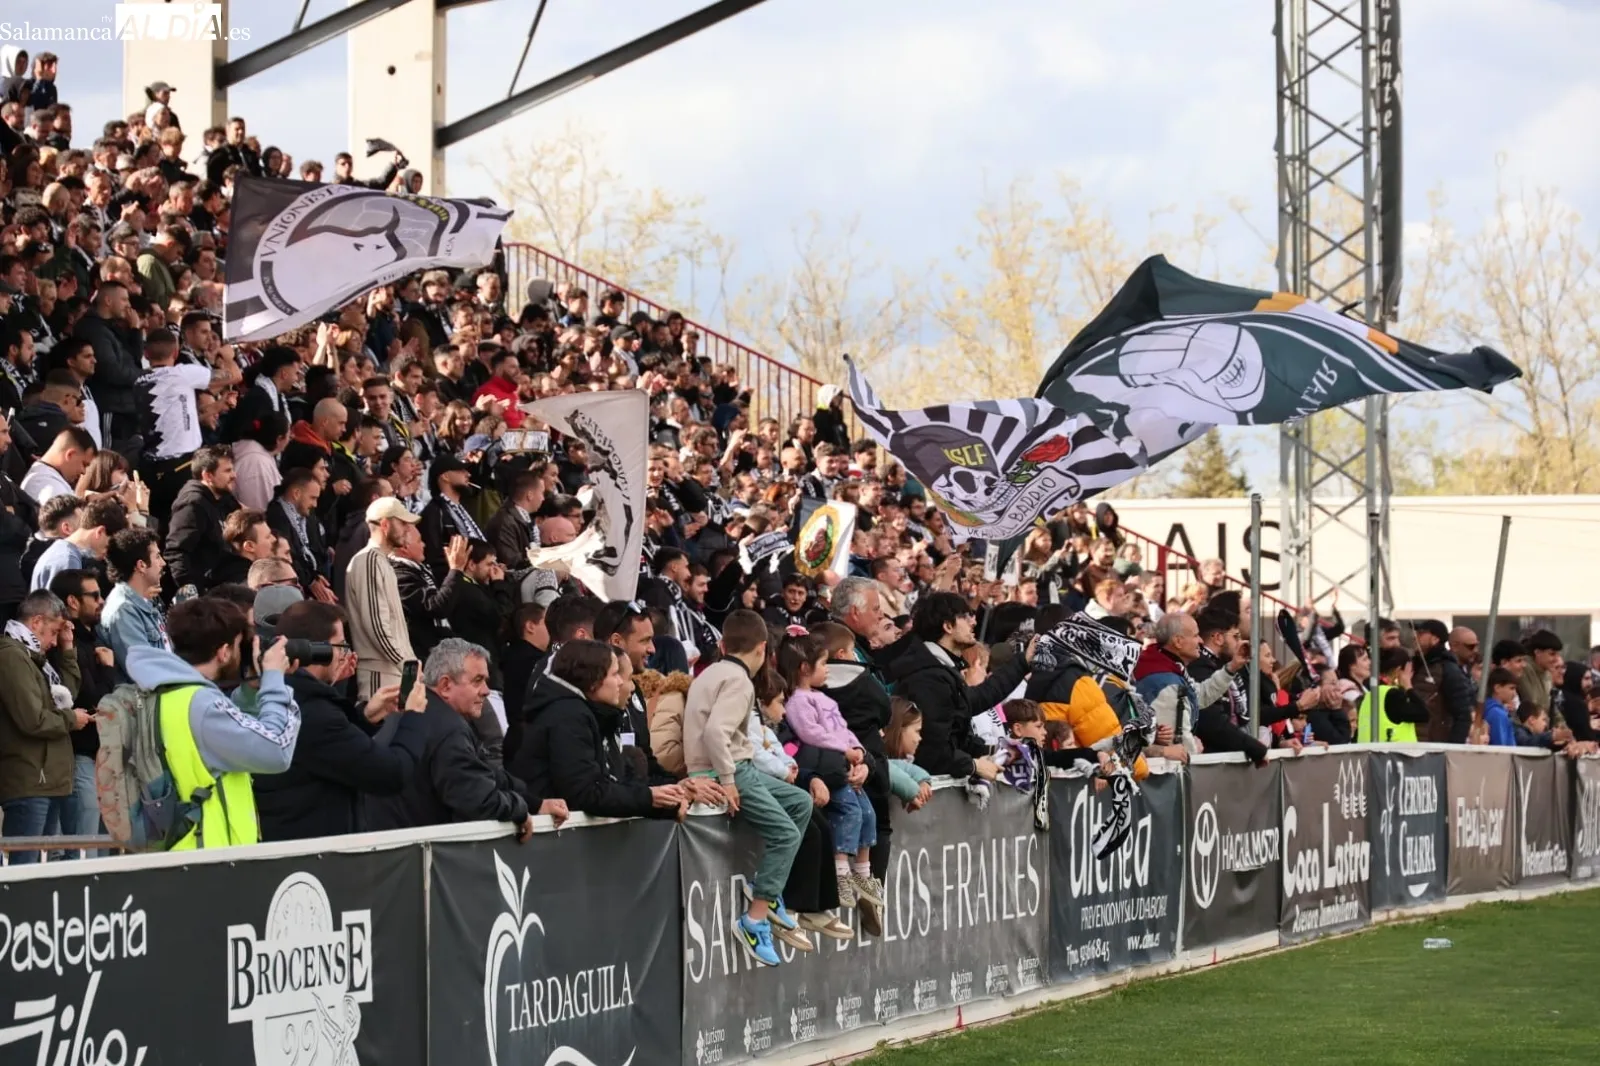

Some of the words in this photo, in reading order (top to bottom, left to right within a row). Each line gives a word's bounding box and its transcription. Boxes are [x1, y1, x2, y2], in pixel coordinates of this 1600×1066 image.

[1284, 805, 1320, 898] Coco
[1323, 802, 1370, 889] Lastra
[883, 848, 931, 943] LOS
[942, 833, 1041, 931] FRAILES
[230, 922, 369, 1011] BROCENSE
[505, 961, 634, 1033] TARDAGUILA
[843, 994, 862, 1011] turismo
[705, 1027, 725, 1043] turismo
[752, 1014, 772, 1032] turismo
